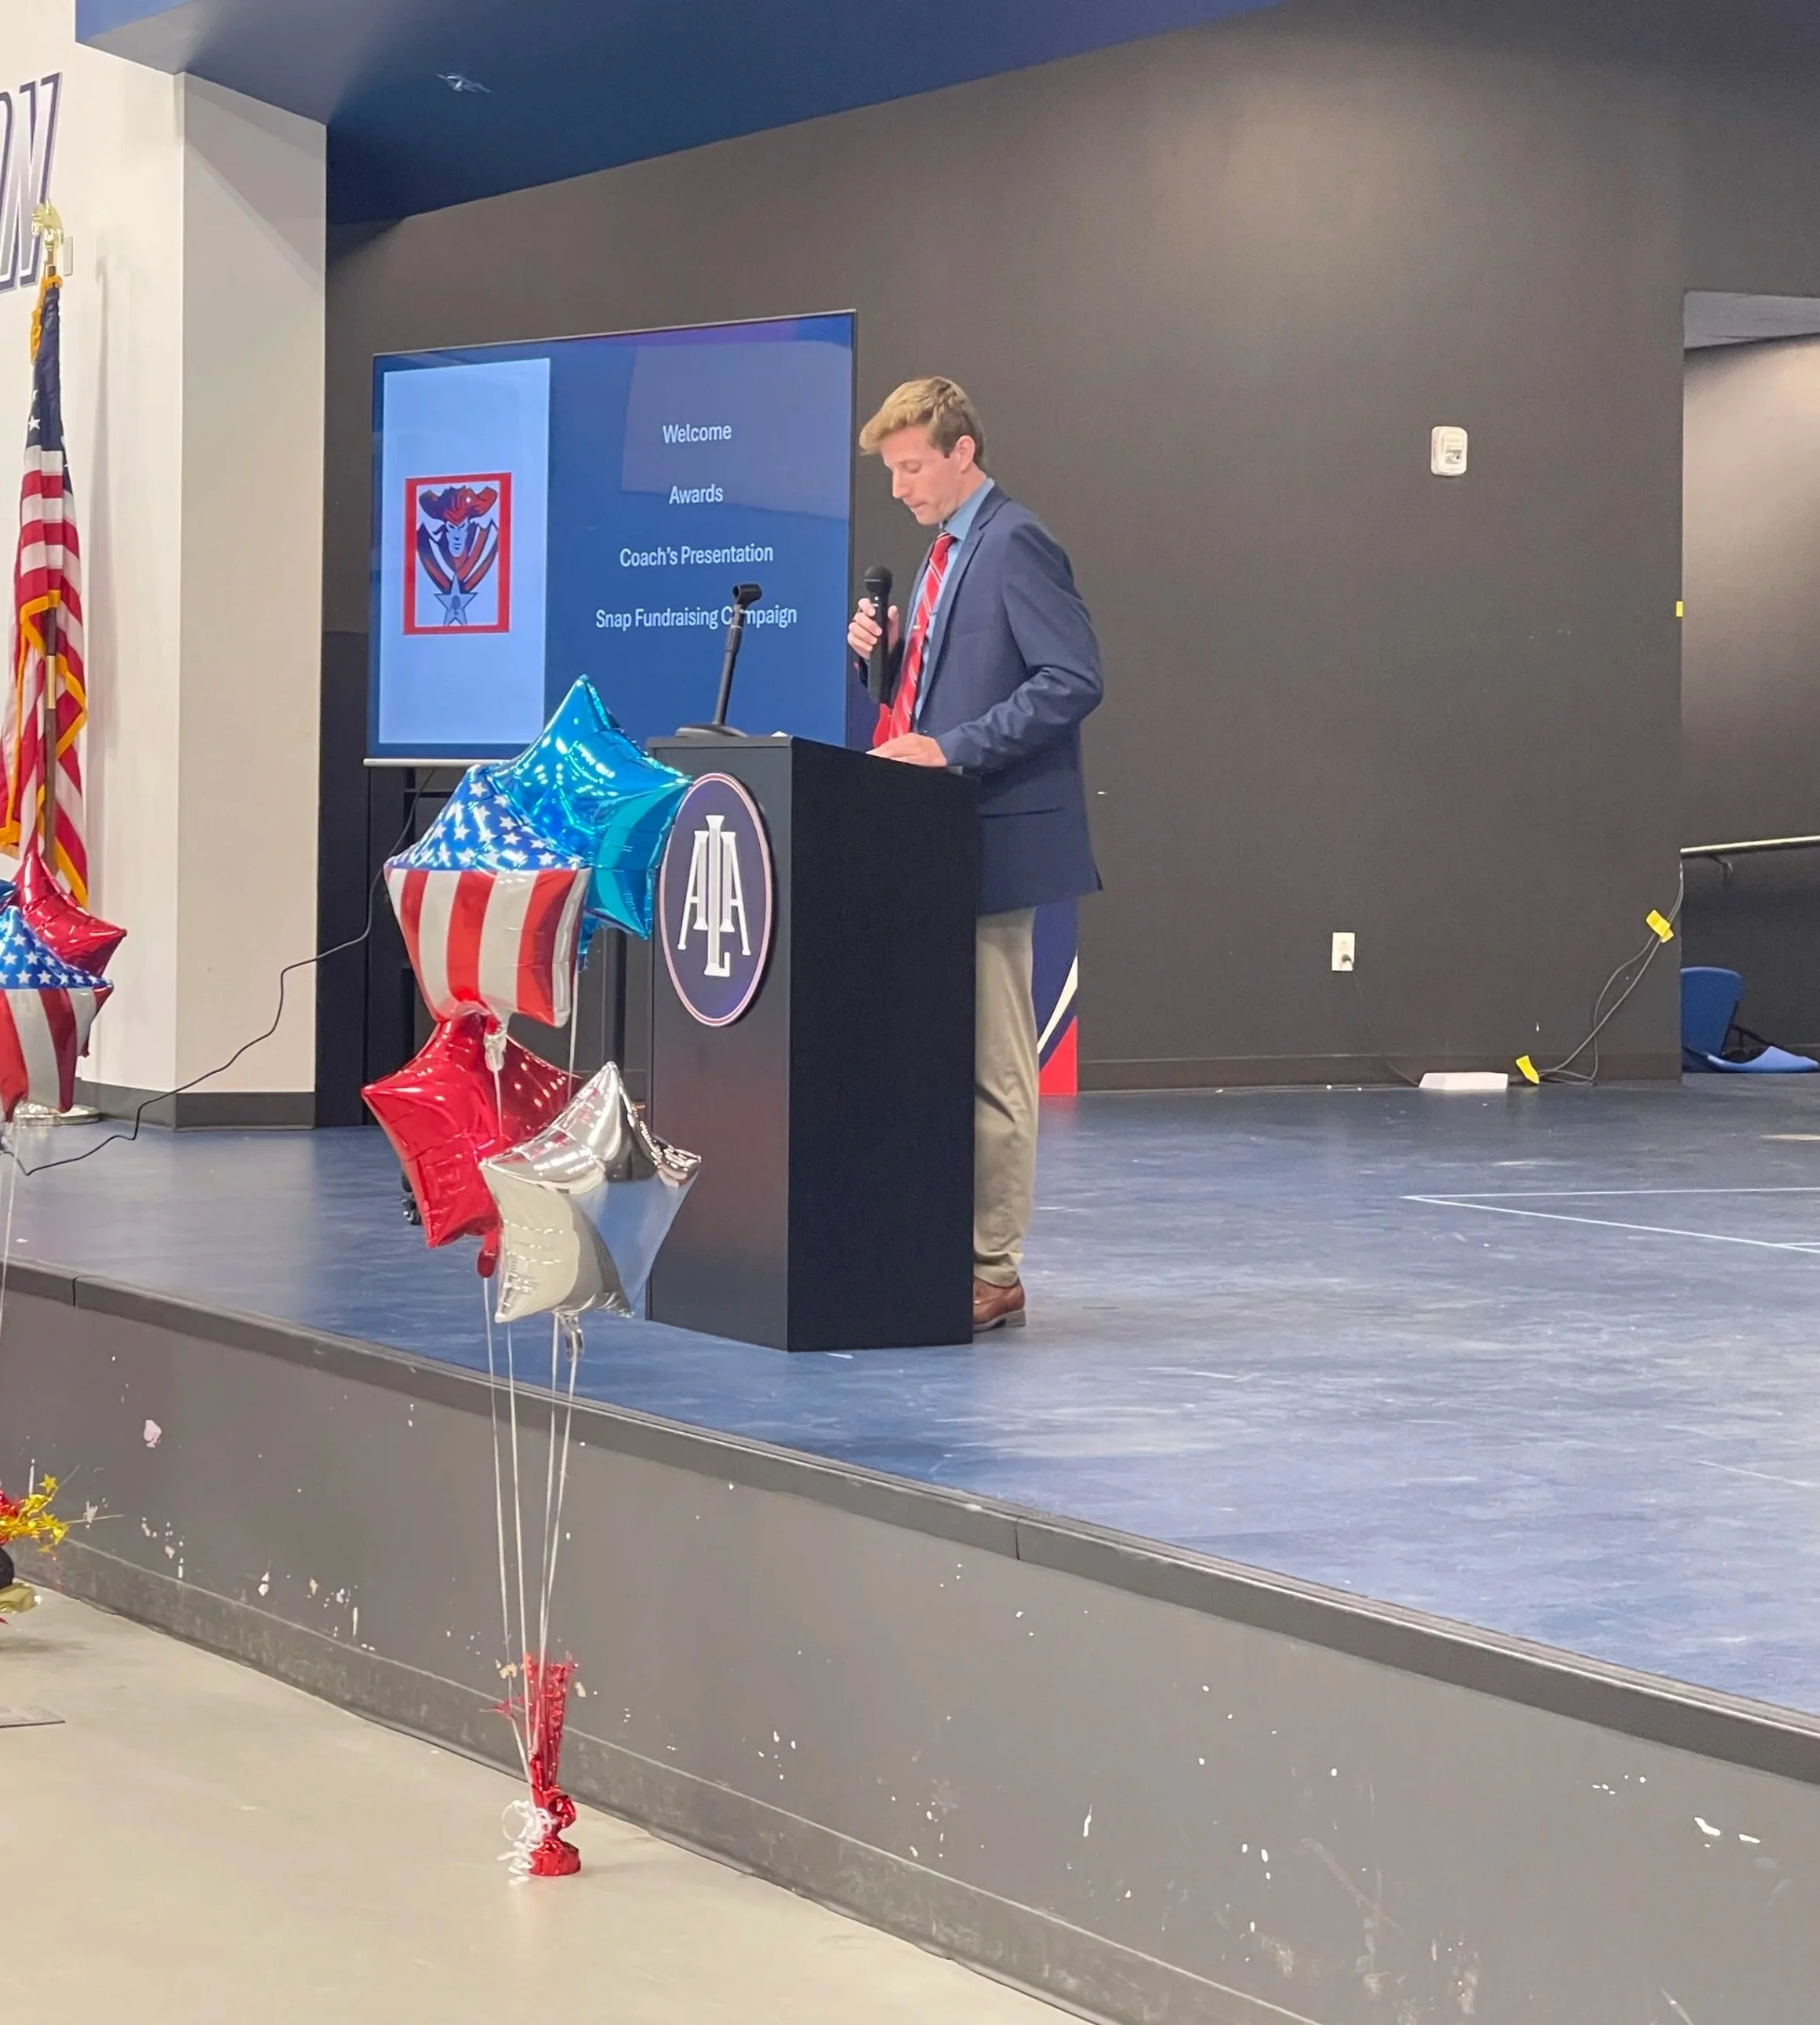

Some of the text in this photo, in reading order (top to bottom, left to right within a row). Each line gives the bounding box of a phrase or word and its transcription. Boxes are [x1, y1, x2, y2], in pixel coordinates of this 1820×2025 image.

[663, 424, 732, 443] Welcome
[668, 484, 724, 504] Awards
[681, 544, 774, 565] Presentation
[595, 605, 797, 631] Snap Fundraising Cmpaign
